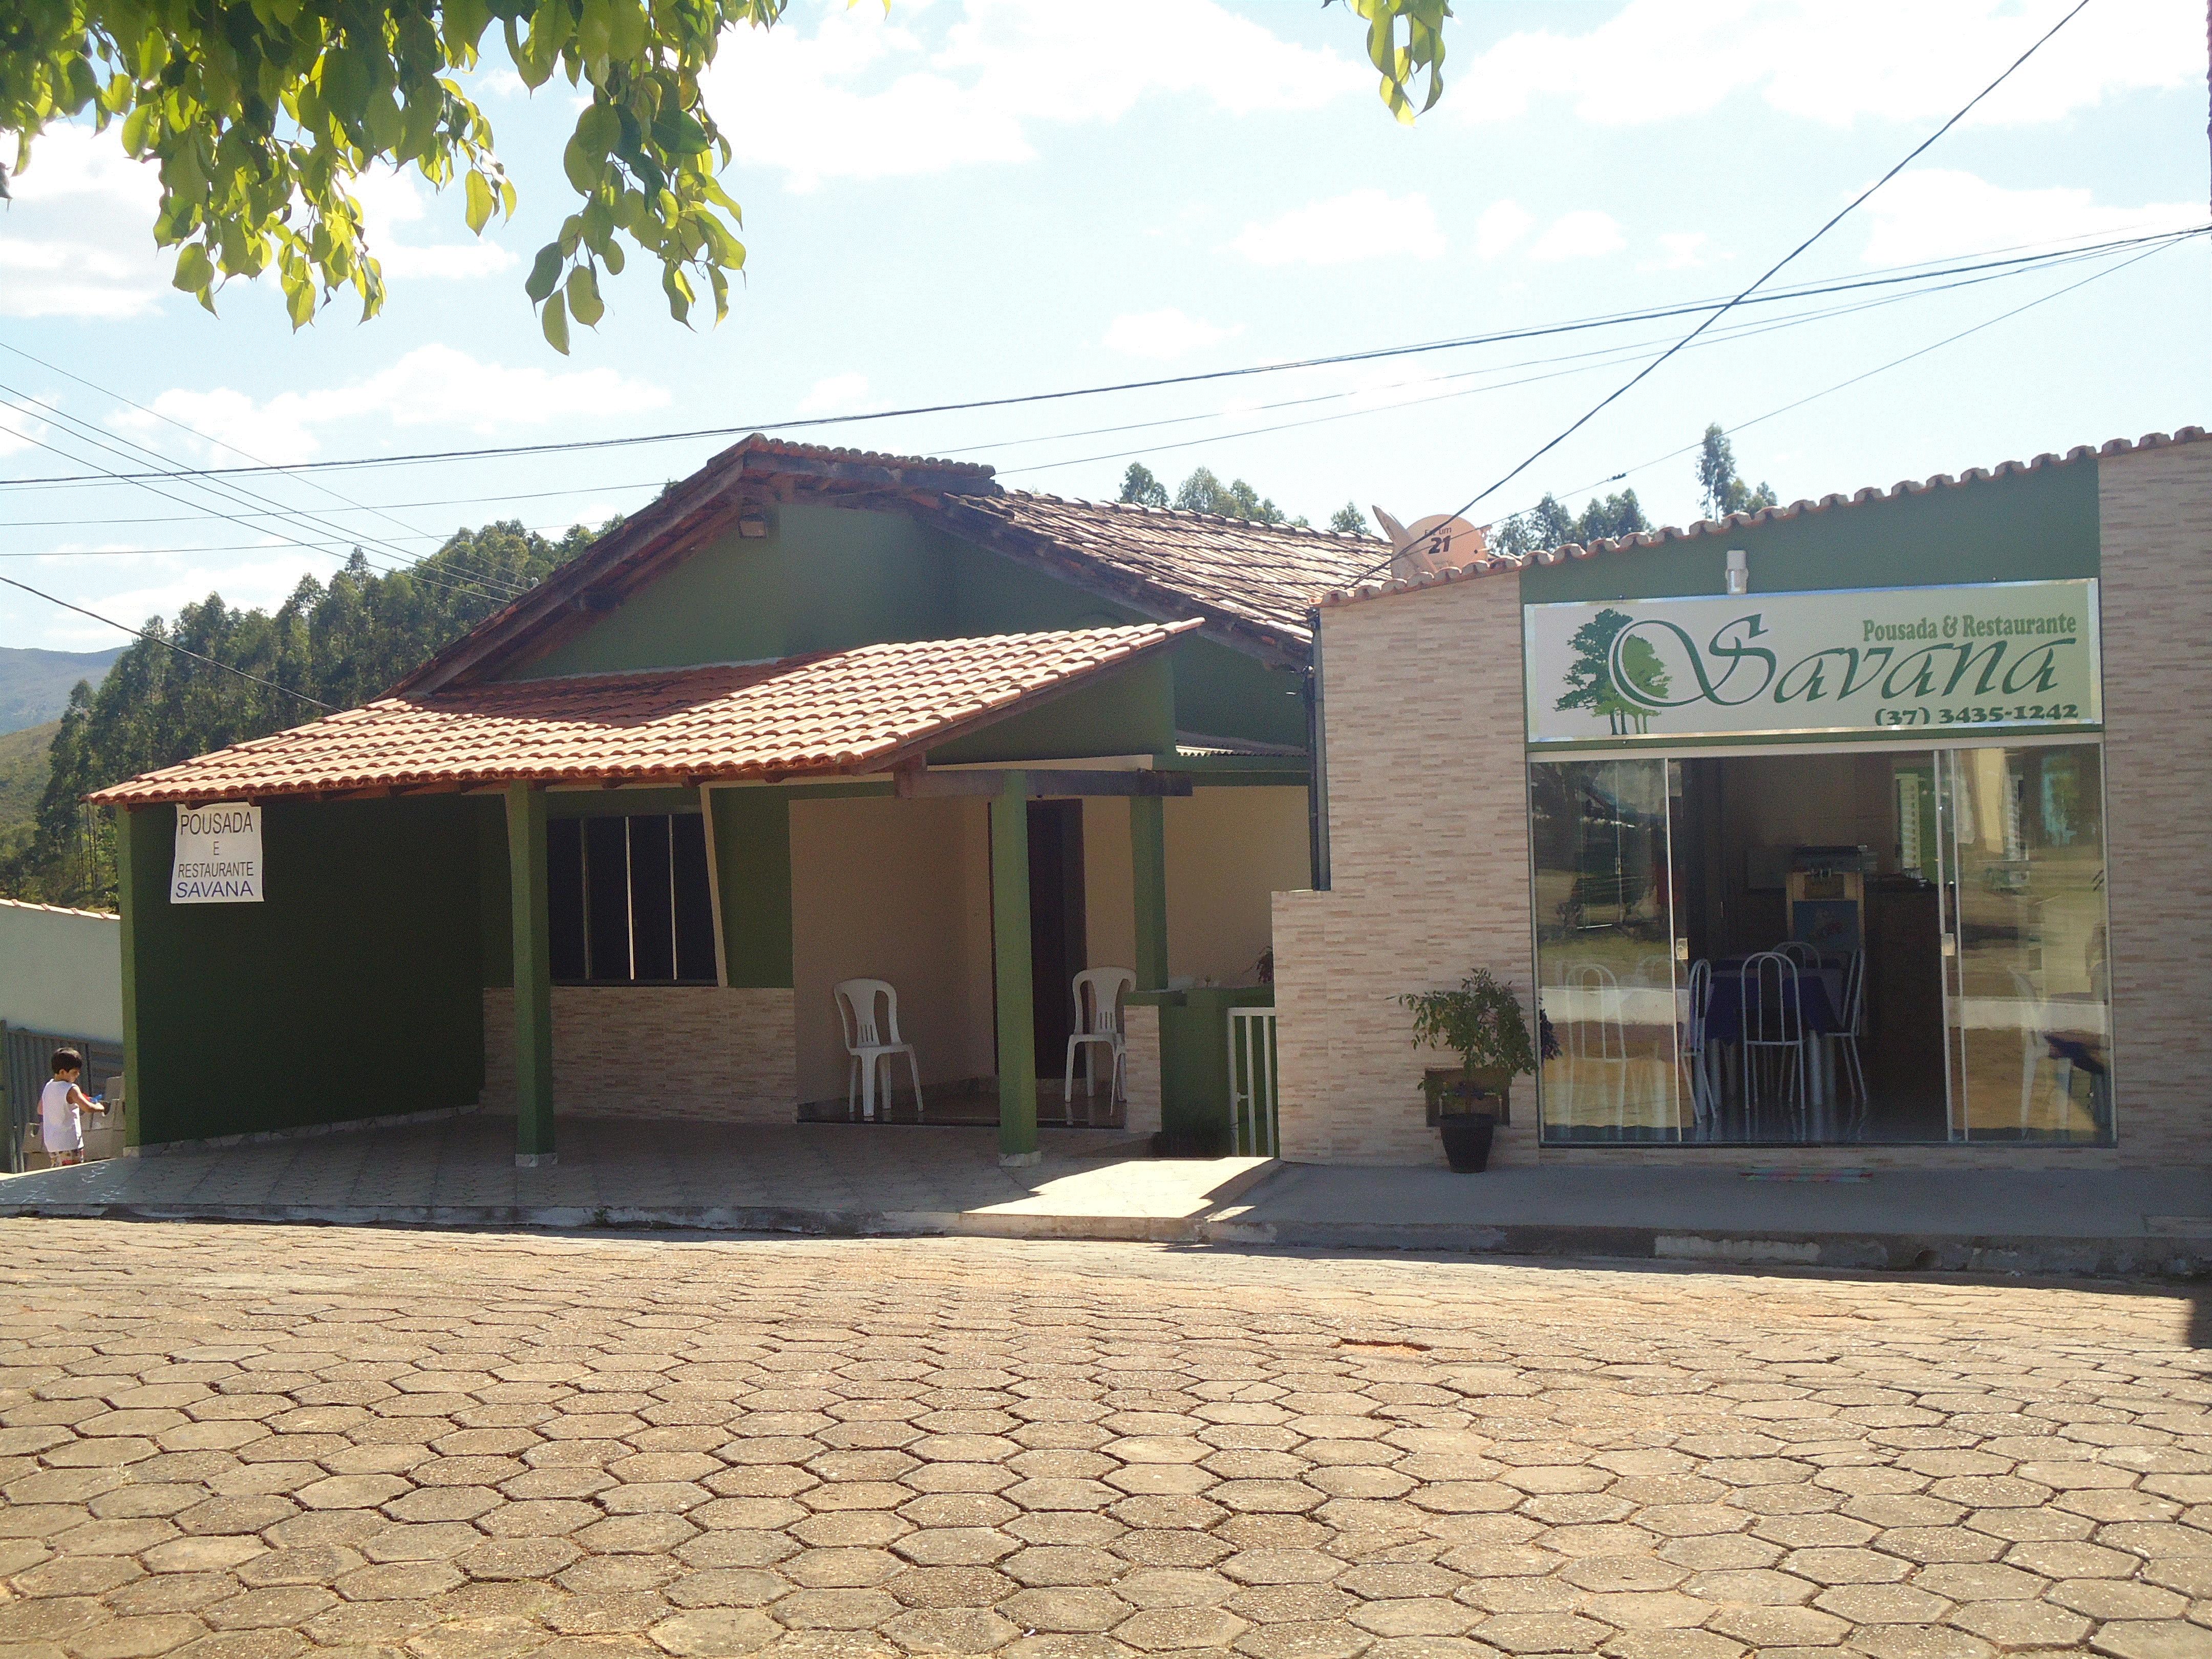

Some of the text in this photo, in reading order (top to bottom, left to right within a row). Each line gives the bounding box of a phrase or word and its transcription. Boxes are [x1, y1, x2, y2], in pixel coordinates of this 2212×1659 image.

[1429, 535, 1451, 554] 21
[1863, 613, 2076, 641] Pousada & Restaurante
[1613, 614, 2076, 711] Savana
[1875, 704, 2078, 726] (37) 3435-1242
[181, 812, 253, 835] POUSADA
[213, 841, 220, 856] E
[178, 861, 254, 878] RESTAURANTE
[176, 881, 254, 898] SAVANA
